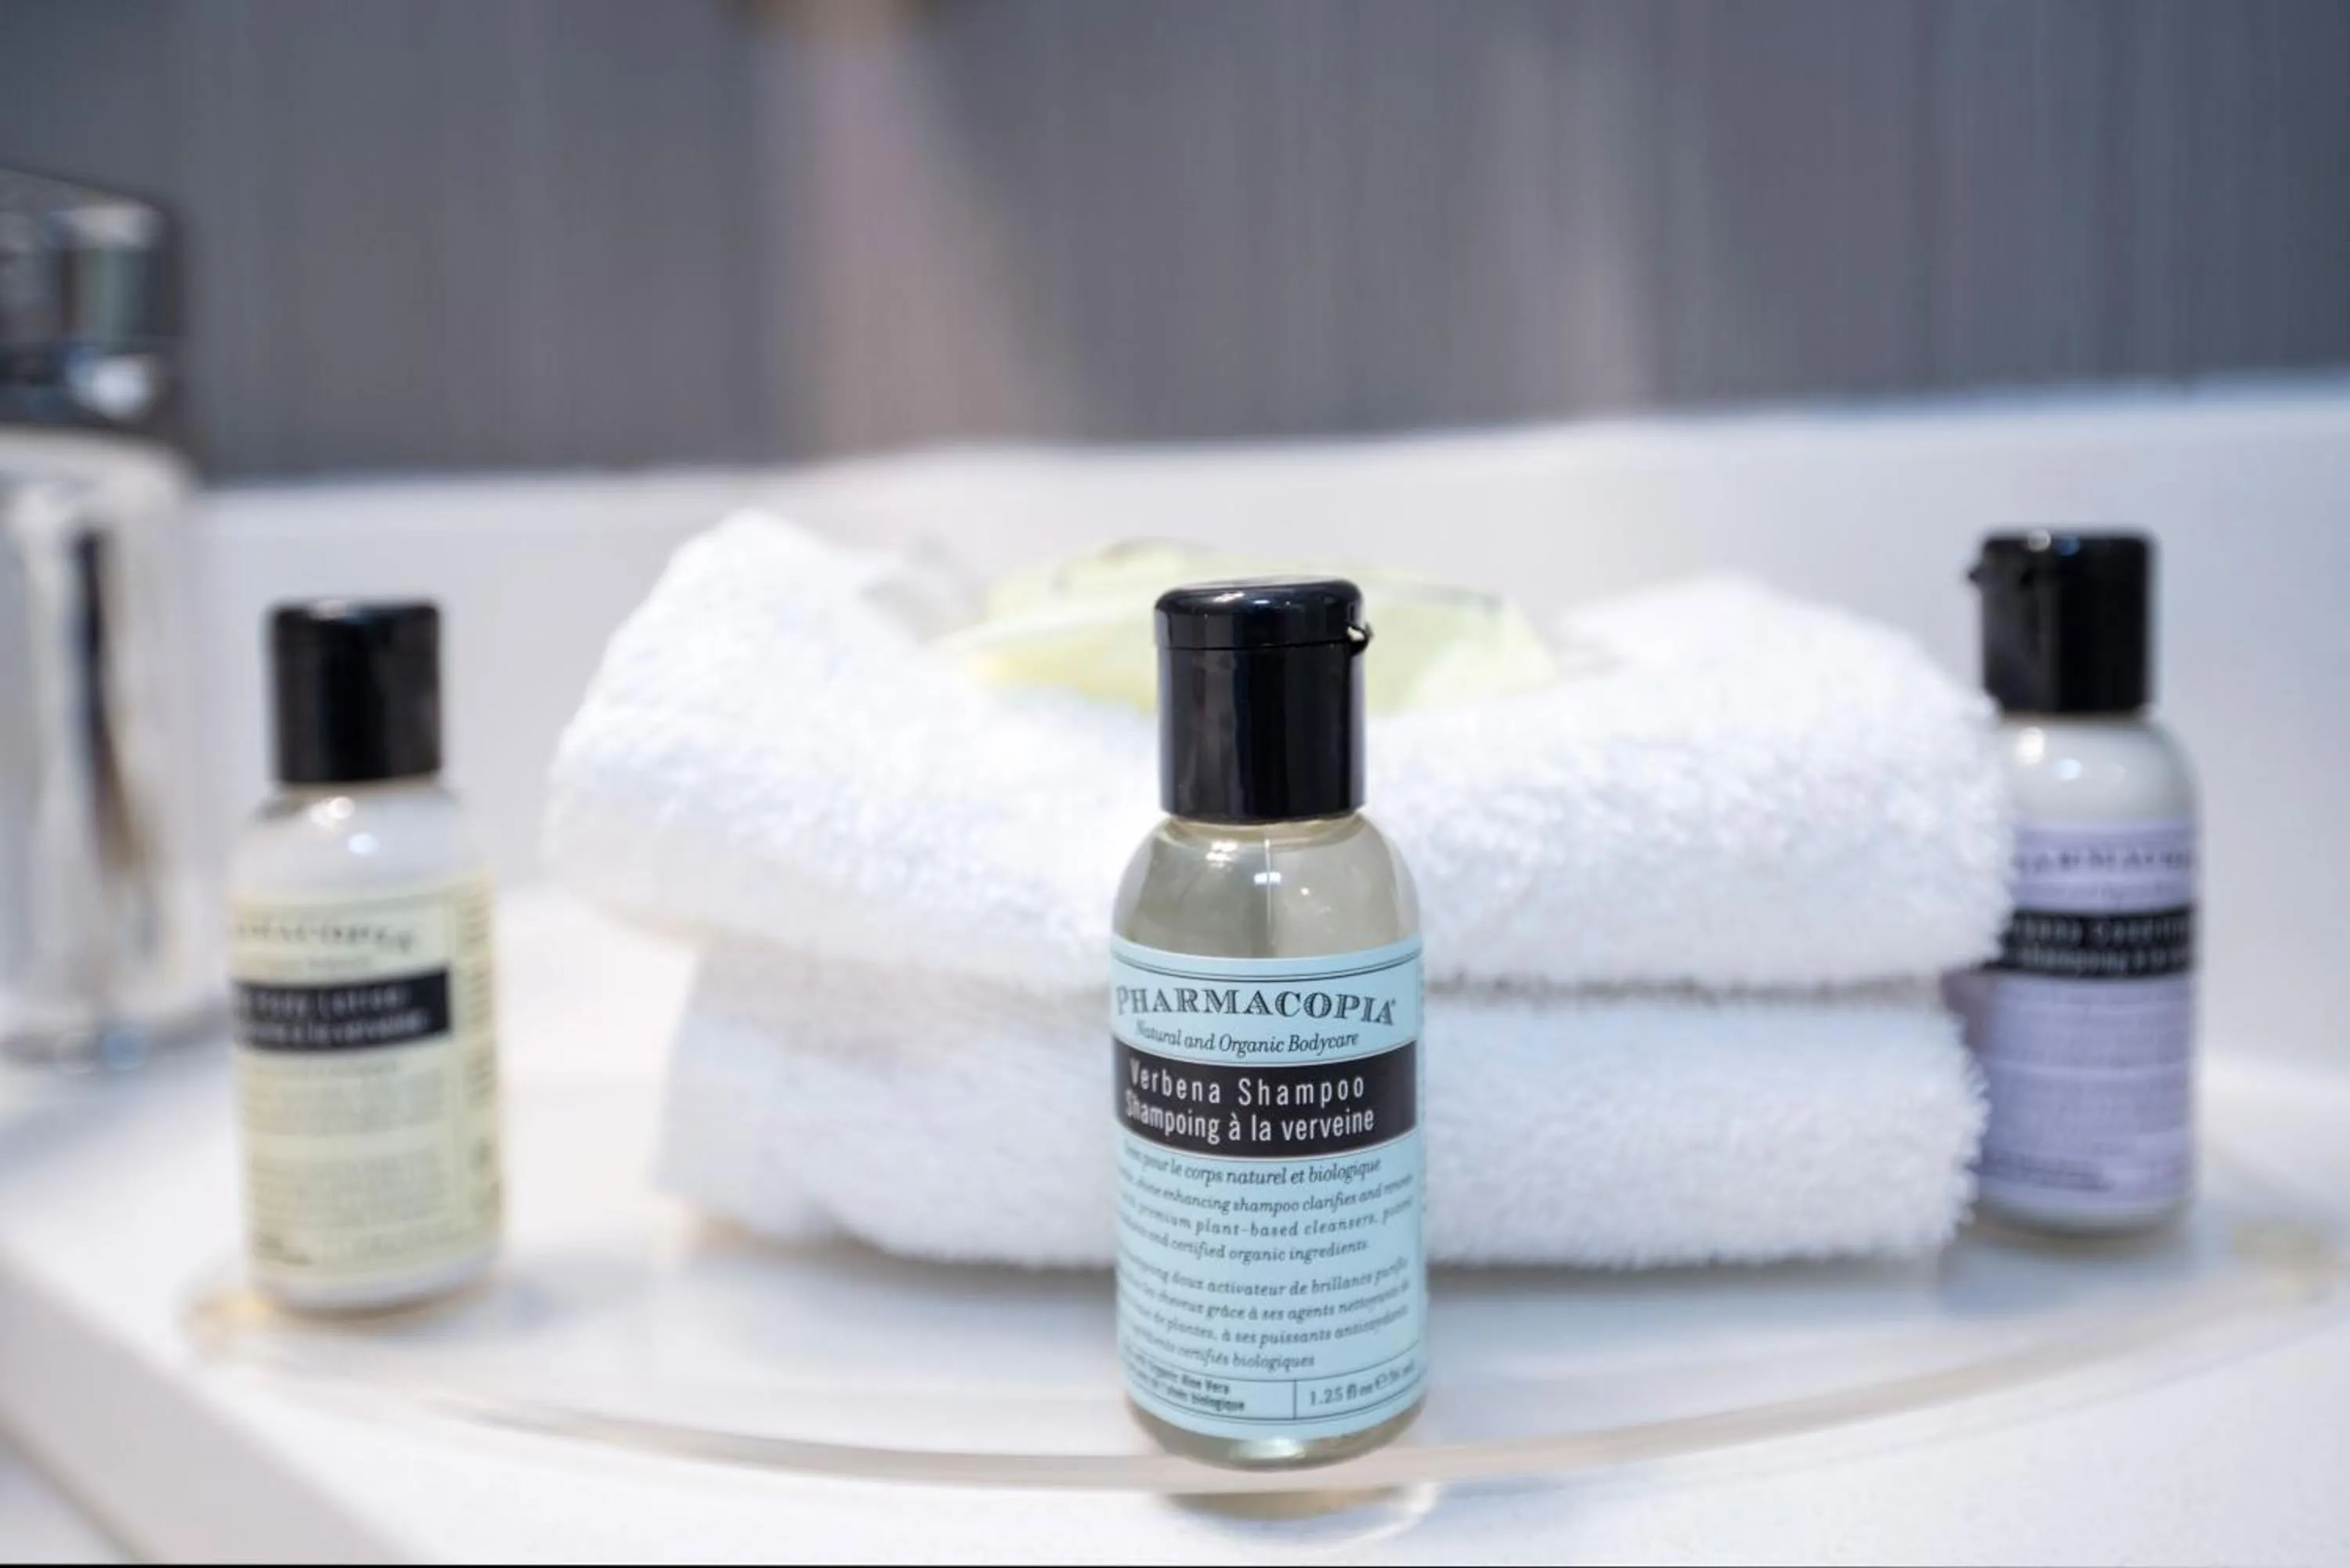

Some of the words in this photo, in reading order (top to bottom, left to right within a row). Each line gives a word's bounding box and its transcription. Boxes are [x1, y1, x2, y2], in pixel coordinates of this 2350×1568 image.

[1115, 986, 1394, 1027] PHARMACOPIA
[1135, 1019, 1181, 1046] Natural
[1184, 1033, 1216, 1052] and
[1218, 1034, 1284, 1058] Organic
[1288, 1031, 1359, 1057] Bodycare
[1129, 1057, 1221, 1104] Verbena
[1238, 1076, 1365, 1107] Shampoo
[1124, 1089, 1220, 1145] Shampoing
[1227, 1113, 1242, 1142] à
[1251, 1114, 1272, 1142] la
[1281, 1107, 1375, 1142] verveine
[1184, 1165, 1224, 1187] corps
[1226, 1166, 1287, 1186] naturel
[1290, 1168, 1305, 1185] et
[1308, 1158, 1382, 1185] biologique
[1162, 1187, 1231, 1215] enhancing
[1232, 1196, 1300, 1218] shampoo
[1302, 1190, 1358, 1213] clarifies
[1358, 1182, 1383, 1202] and
[1195, 1218, 1299, 1238] plant-based
[1170, 1237, 1227, 1261] certified
[1228, 1247, 1287, 1266] organic
[1207, 1280, 1287, 1297] activateur
[1289, 1280, 1309, 1296] de
[1311, 1273, 1372, 1294] brillance
[1207, 1303, 1246, 1321] grâce
[1247, 1306, 1258, 1321] à
[1262, 1309, 1284, 1321] ses
[1287, 1304, 1336, 1325] agents
[1220, 1328, 1231, 1342] à
[1235, 1331, 1257, 1343] ses
[1258, 1329, 1332, 1350] puissants
[1231, 1351, 1316, 1374] biologiques
[1309, 1386, 1344, 1407] 1.25
